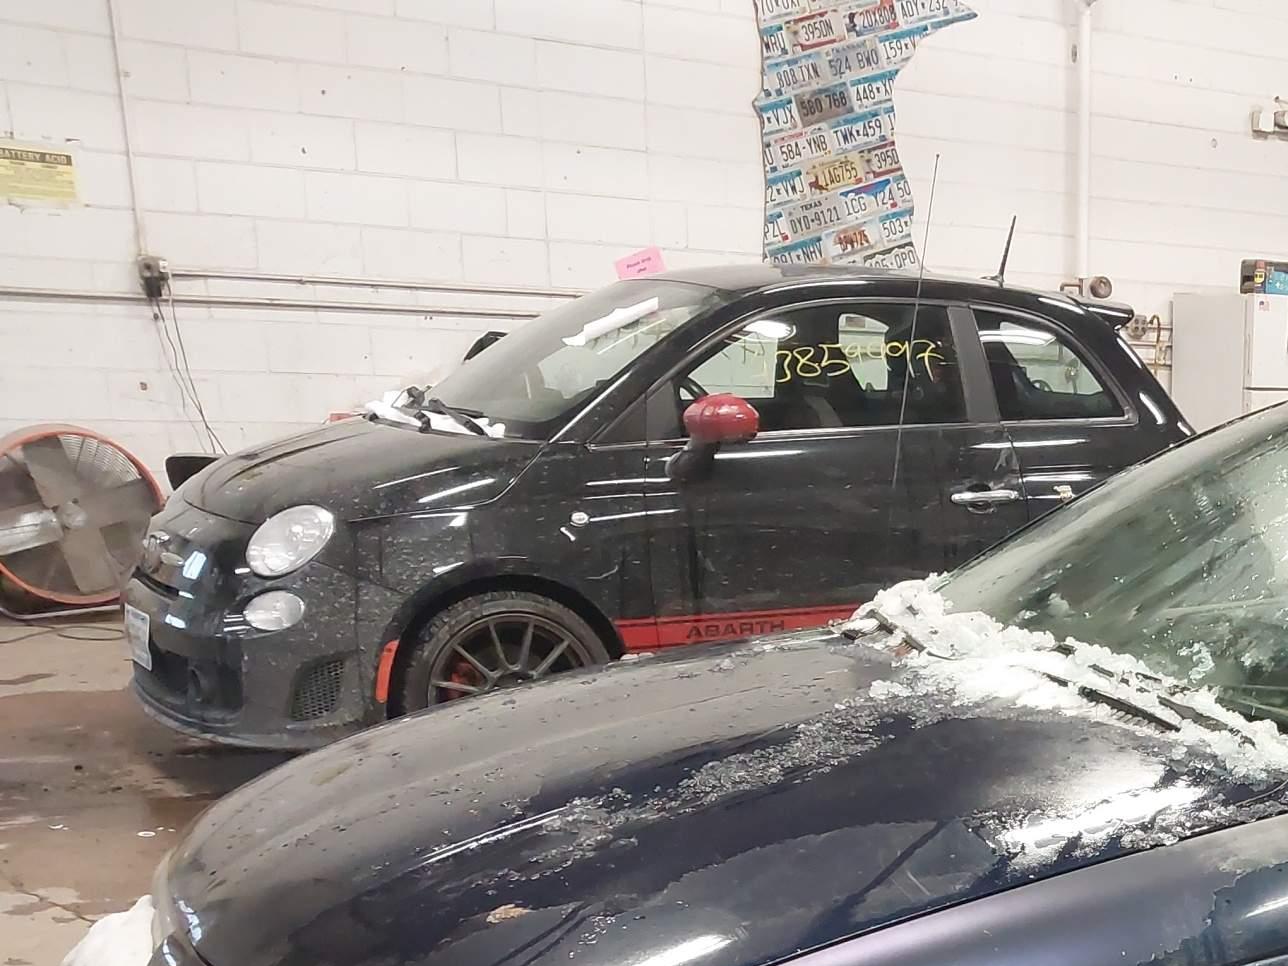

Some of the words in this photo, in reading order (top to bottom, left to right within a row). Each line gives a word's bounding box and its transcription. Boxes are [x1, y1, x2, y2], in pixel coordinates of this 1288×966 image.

[828, 56, 853, 77] 524
[776, 68, 798, 88] 808
[801, 98, 823, 117] 580
[825, 91, 847, 109] 768
[833, 125, 857, 147] TWK
[862, 118, 882, 138] 459
[45, 154, 67, 164] ACID
[800, 200, 823, 211] TEXAS
[686, 620, 785, 639] ABARTH
